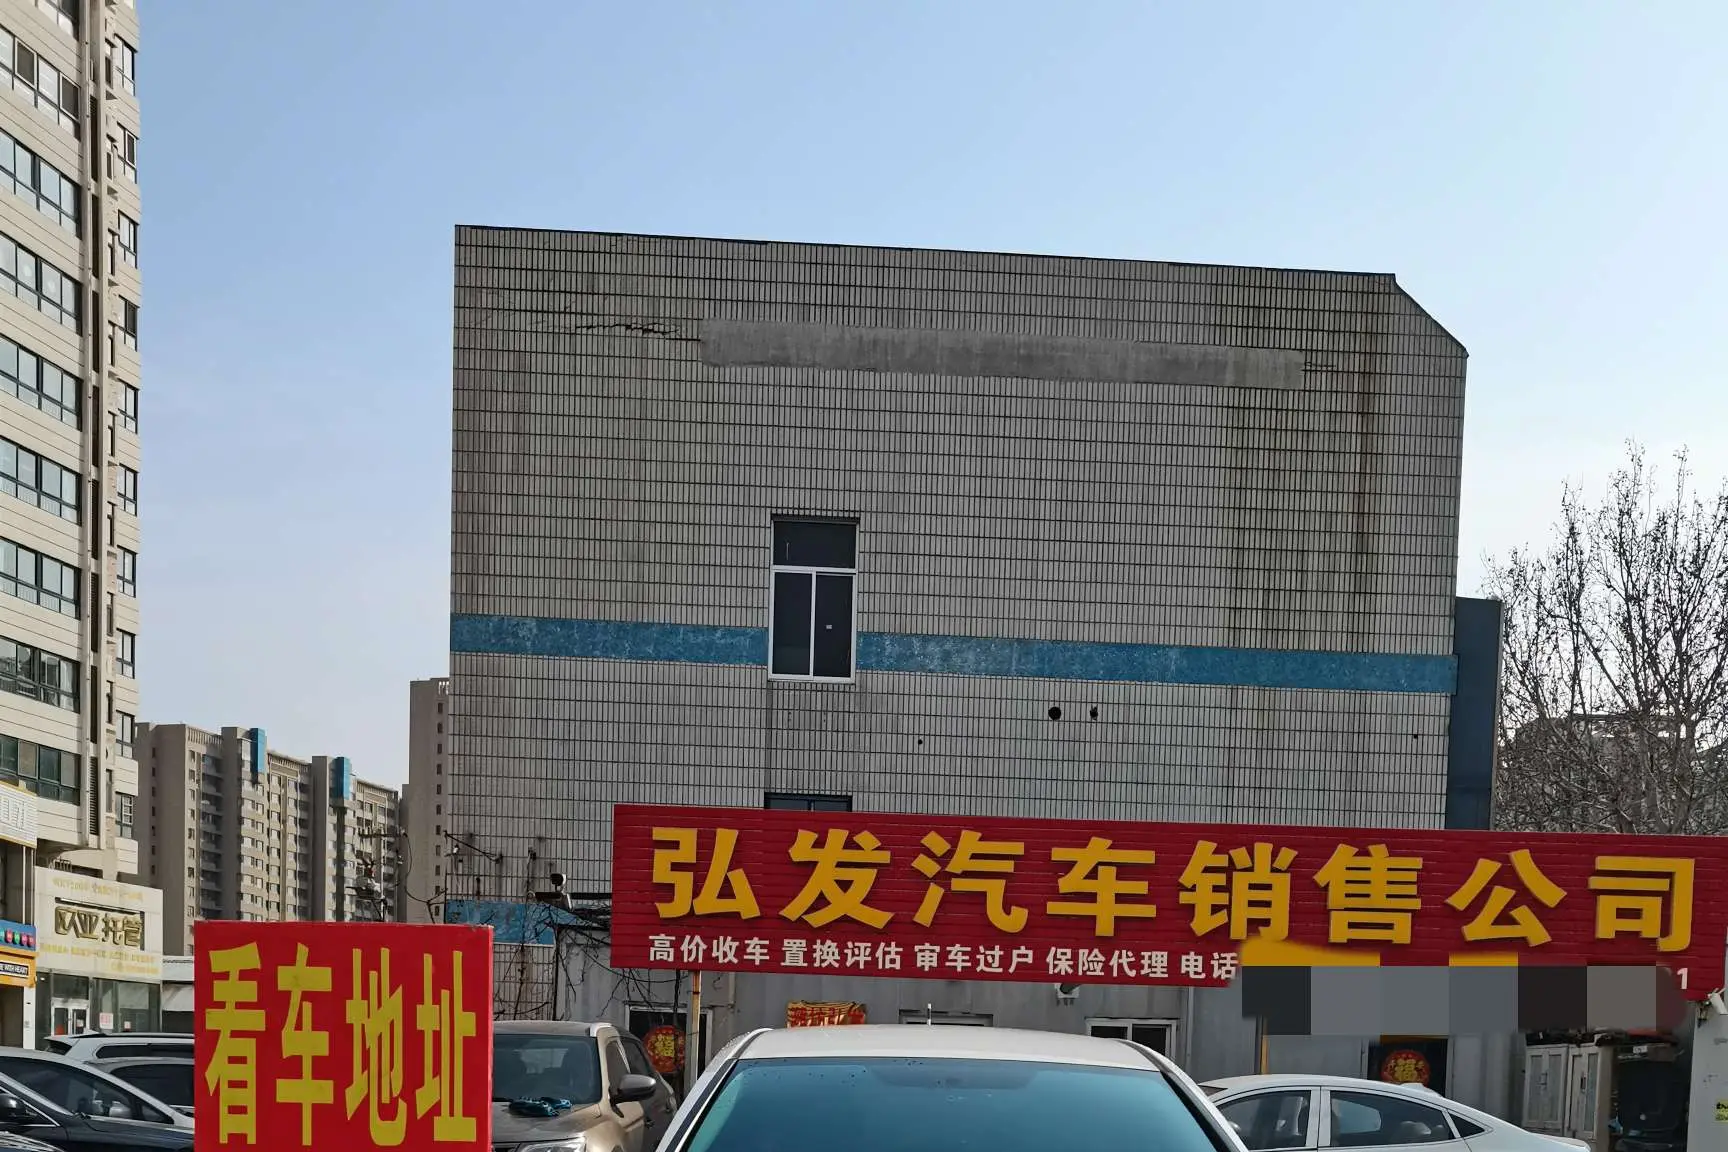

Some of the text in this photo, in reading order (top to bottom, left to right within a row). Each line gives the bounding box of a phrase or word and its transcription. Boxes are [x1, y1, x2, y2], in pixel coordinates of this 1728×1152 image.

[651, 826, 1695, 952] 弘发汽车销售公司
[648, 934, 1238, 980] 高价收车 置换评估 审车过户 保险代理 电话
[205, 941, 477, 1147] 看车地址
